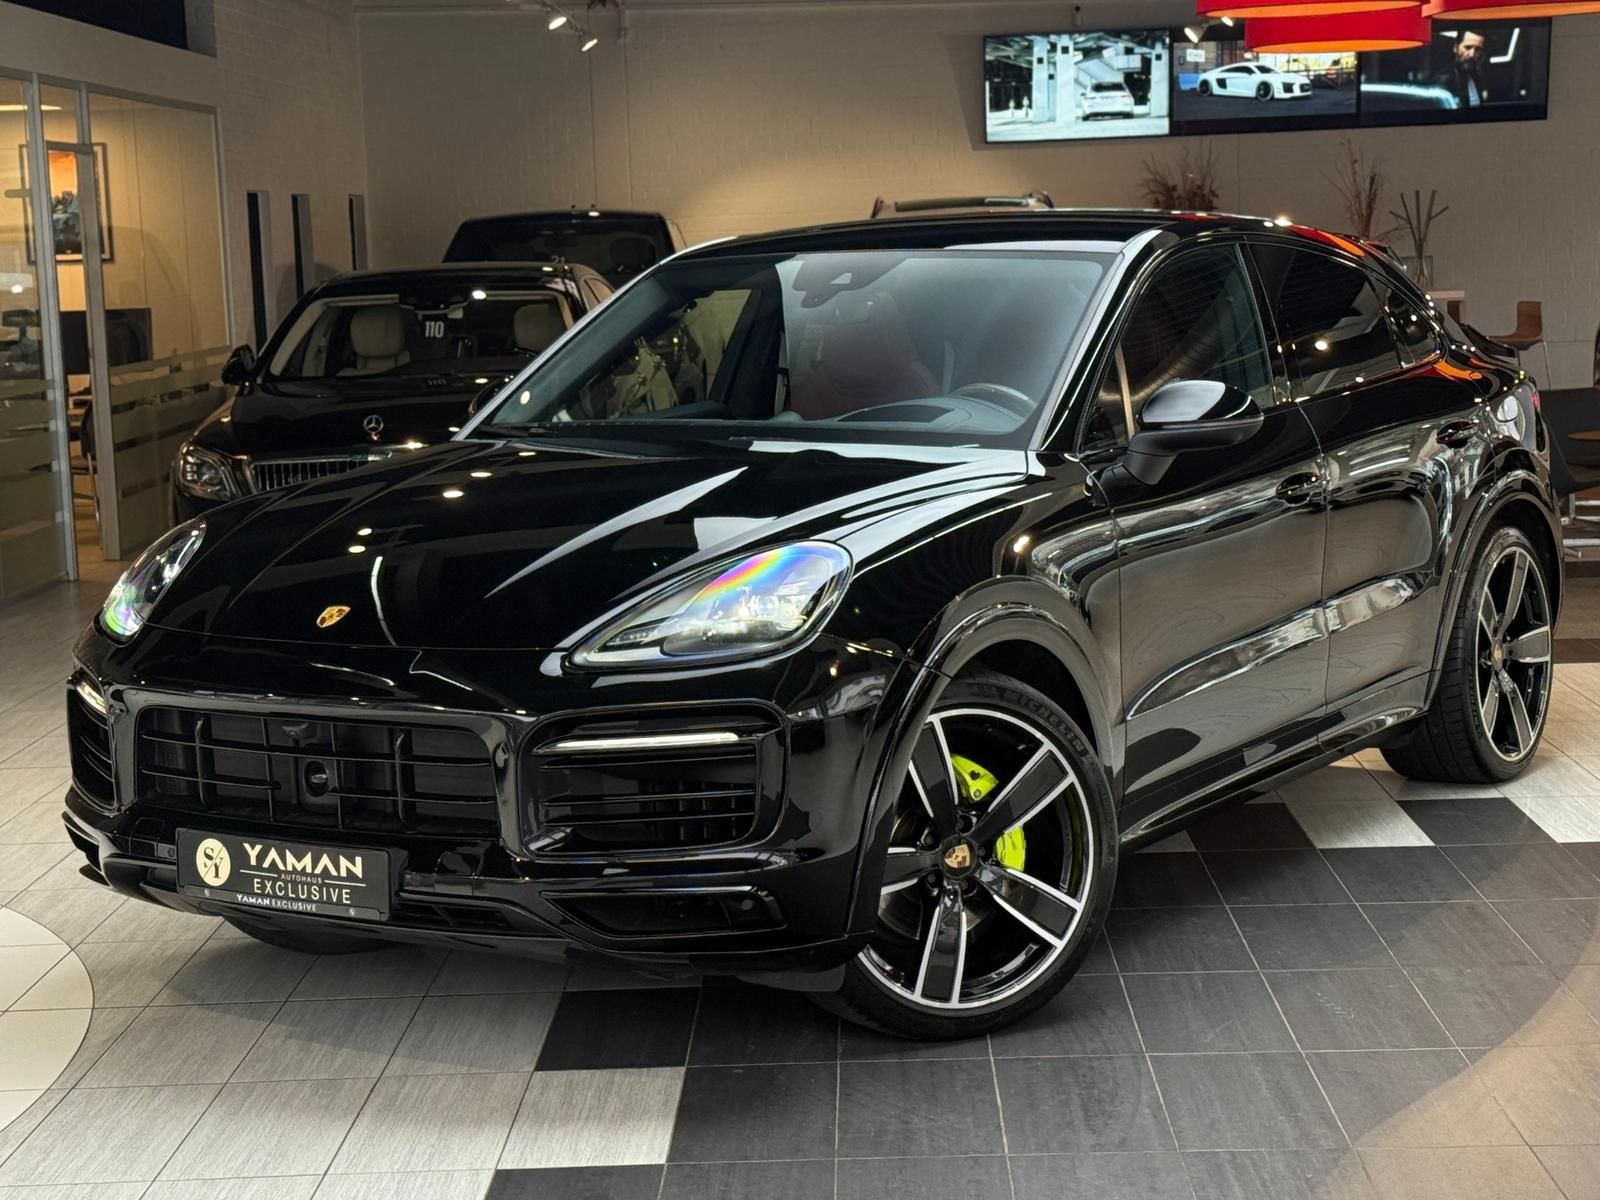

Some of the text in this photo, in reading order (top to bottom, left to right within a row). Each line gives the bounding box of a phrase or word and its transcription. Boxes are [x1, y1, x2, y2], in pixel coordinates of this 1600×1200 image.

[425, 321, 444, 338] 110
[242, 842, 363, 879] YAMAN
[280, 873, 322, 884] AUTOHAUS
[253, 878, 352, 904] EXCLUSIVE
[236, 894, 317, 912] YAMAN EXCLUSIVE
